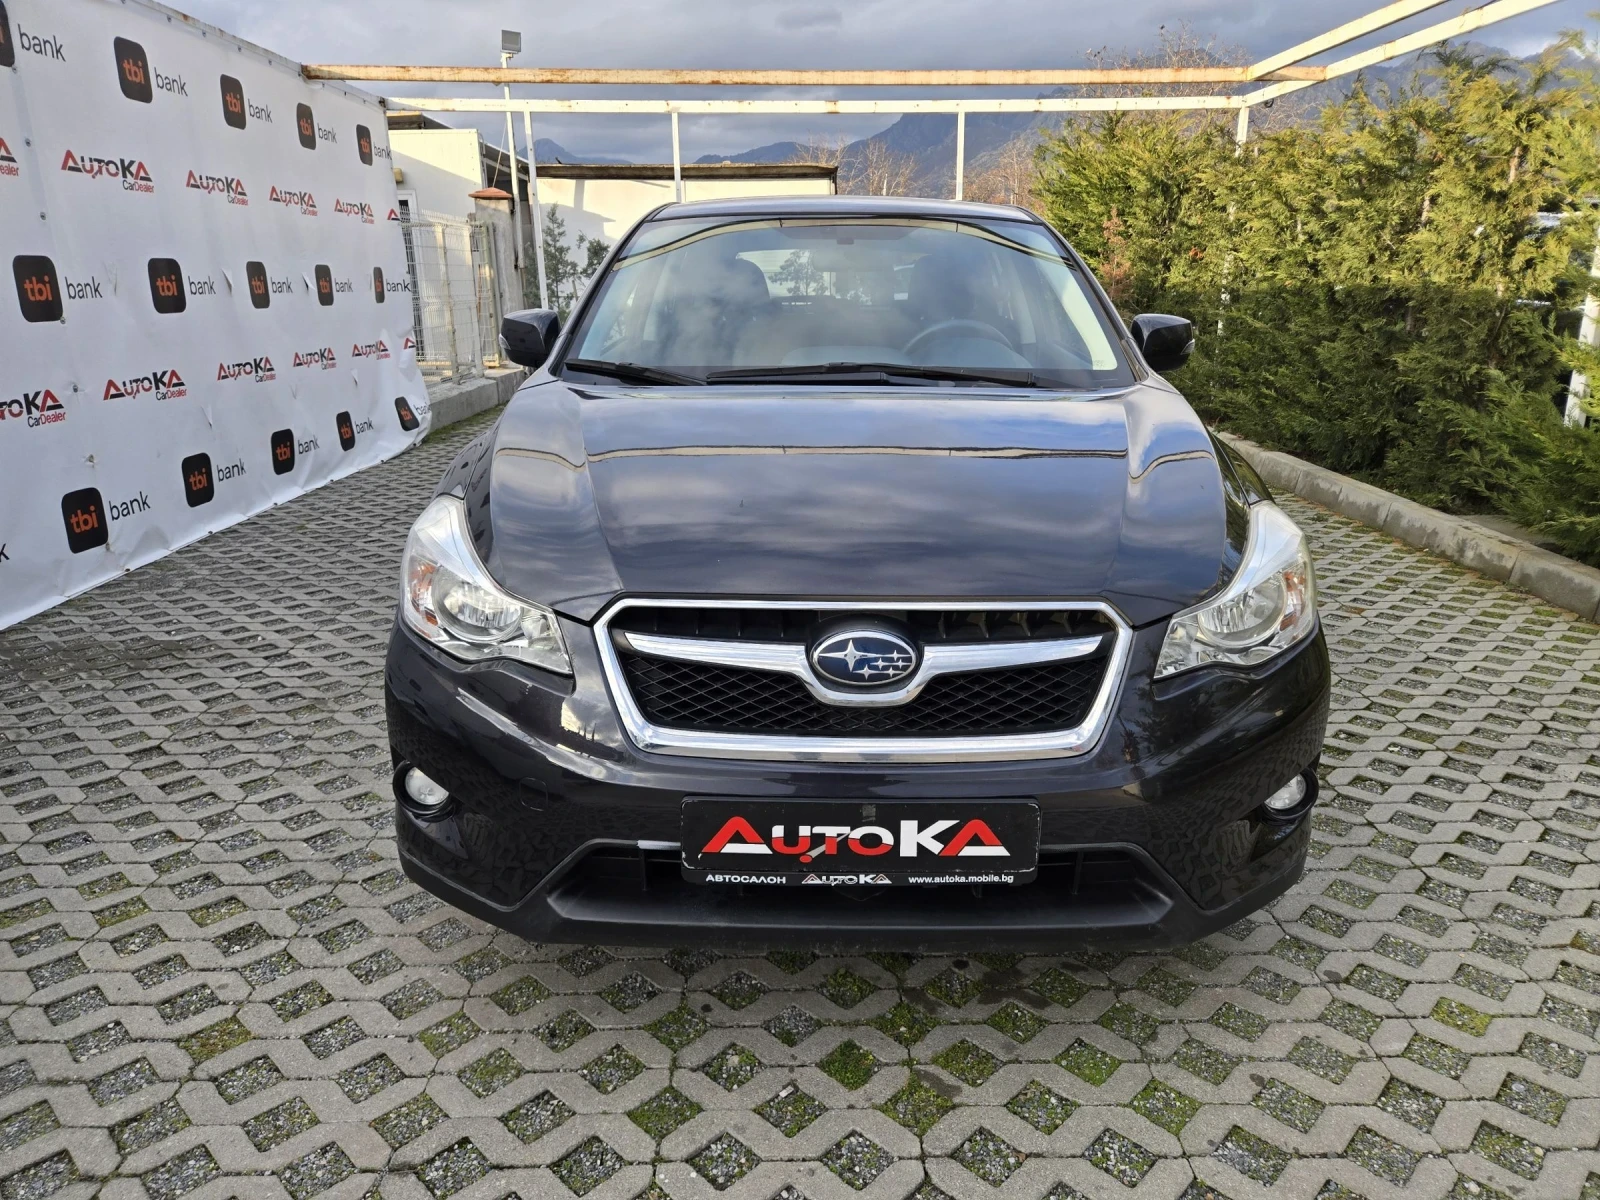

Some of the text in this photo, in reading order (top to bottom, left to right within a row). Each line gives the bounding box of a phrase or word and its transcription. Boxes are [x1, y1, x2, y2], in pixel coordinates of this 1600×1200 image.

[17, 23, 66, 62] bank
[122, 59, 188, 96] tbi bank
[225, 93, 273, 123] tbi bank
[300, 118, 338, 143] tbi bank
[360, 136, 392, 161] tbi bank
[122, 180, 155, 194] CarDealer
[24, 274, 103, 302] tbi bank
[156, 274, 216, 297] tbi bank
[251, 274, 293, 295] tbi bank
[319, 275, 354, 294] tbi bank
[386, 278, 412, 293] bank
[155, 387, 187, 401] CarDealer
[27, 411, 66, 428] CarDealer
[401, 406, 413, 421] tbi
[340, 417, 374, 439] tbi bank
[276, 435, 320, 462] tbi bank
[188, 458, 247, 491] tbi bank
[70, 491, 151, 534] tbi bank
[701, 815, 1011, 863] AUTOKA
[705, 872, 786, 885] АВТОСАЛОН
[908, 873, 1015, 885] www.autoka.mobile.bg
